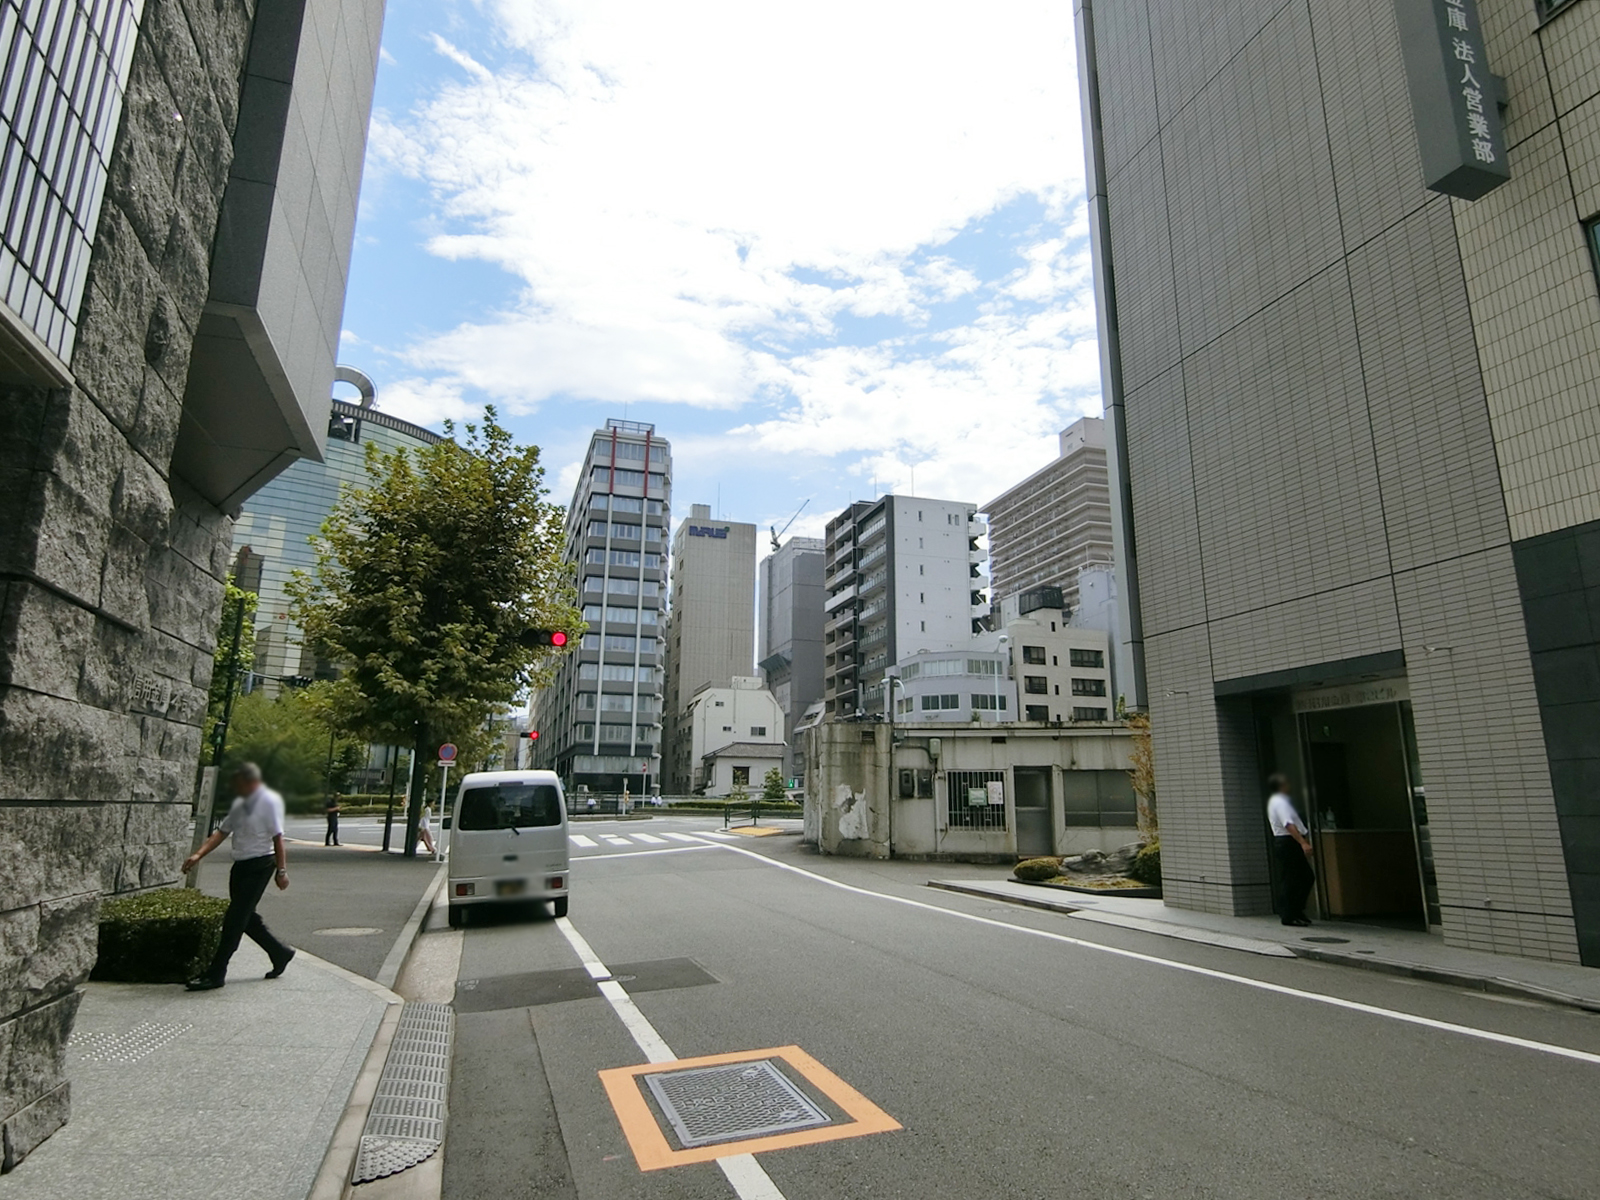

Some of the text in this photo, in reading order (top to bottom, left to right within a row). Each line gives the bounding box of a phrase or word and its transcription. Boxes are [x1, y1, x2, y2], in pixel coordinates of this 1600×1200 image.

[1452, 37, 1495, 164] 法人営業部
